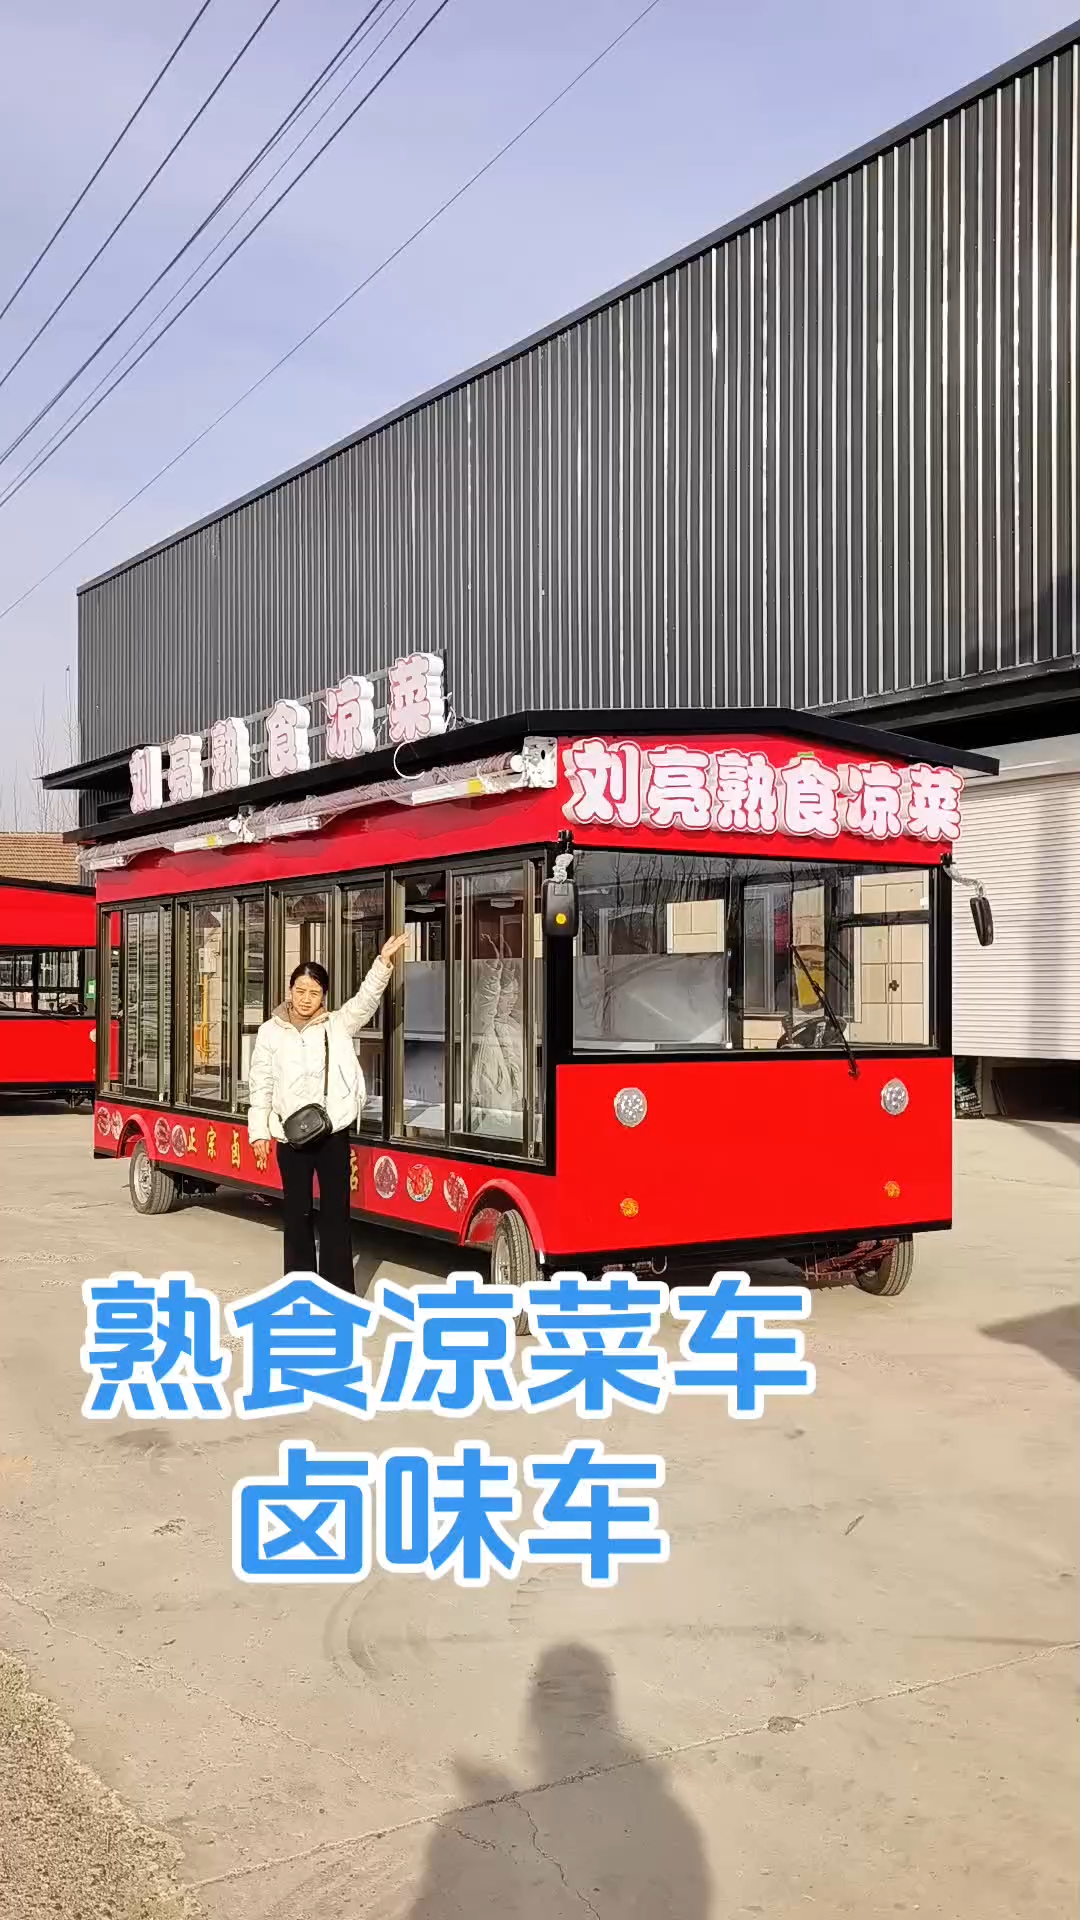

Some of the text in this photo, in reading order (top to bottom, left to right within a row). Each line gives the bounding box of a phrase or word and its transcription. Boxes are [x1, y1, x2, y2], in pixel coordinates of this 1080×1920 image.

[129, 652, 444, 815] 刘亮熟食凉菜
[562, 737, 965, 842] 刘亮熟食凉菜
